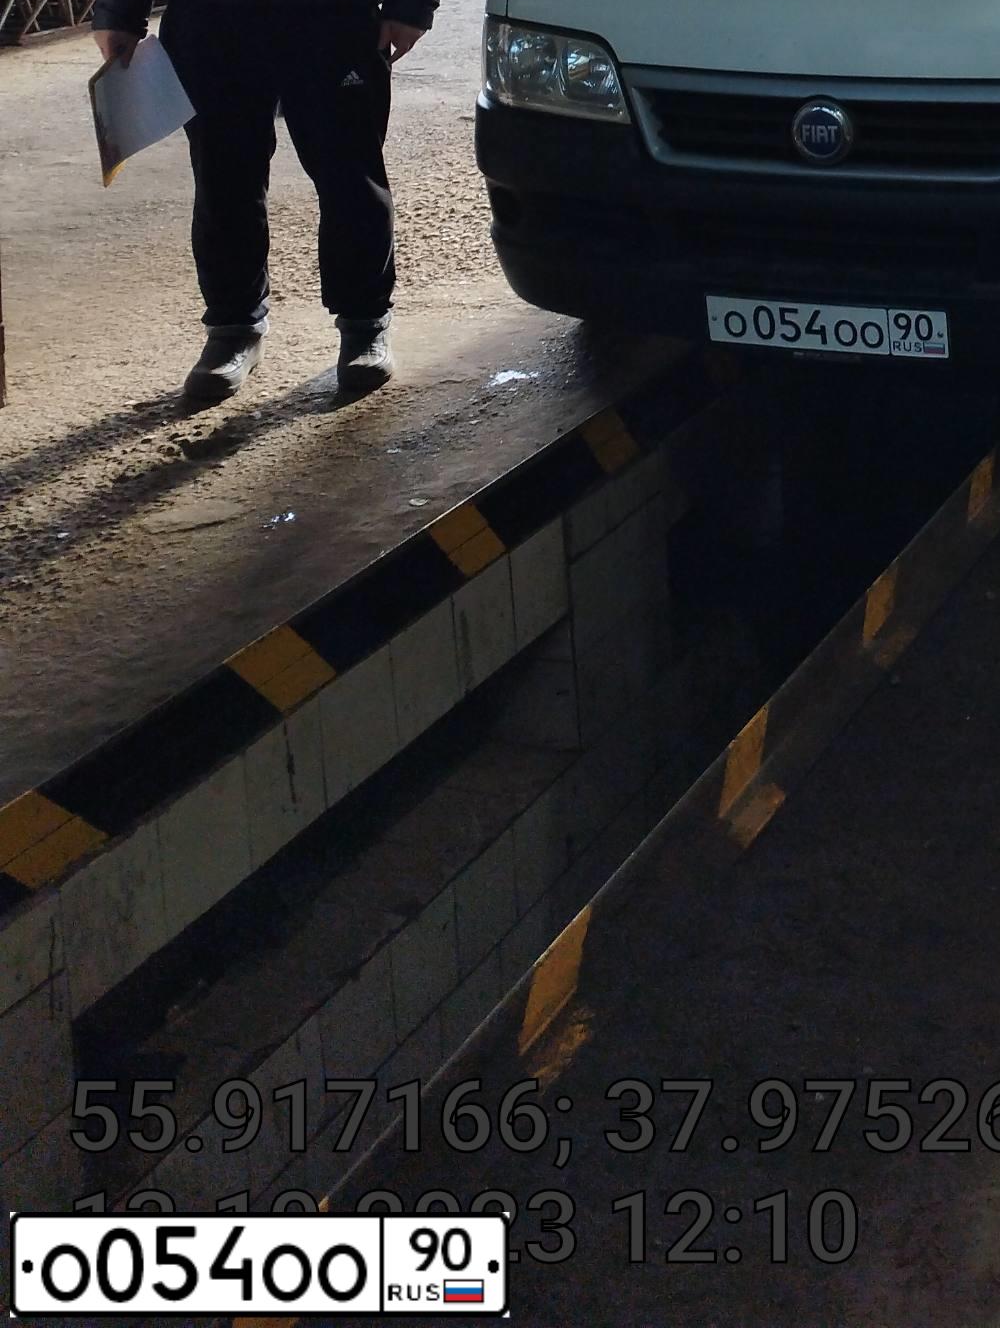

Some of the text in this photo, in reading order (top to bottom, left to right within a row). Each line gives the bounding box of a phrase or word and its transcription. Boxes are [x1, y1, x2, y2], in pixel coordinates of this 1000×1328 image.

[801, 124, 838, 144] FIAT
[893, 312, 934, 341] 90
[892, 340, 922, 353] RUS
